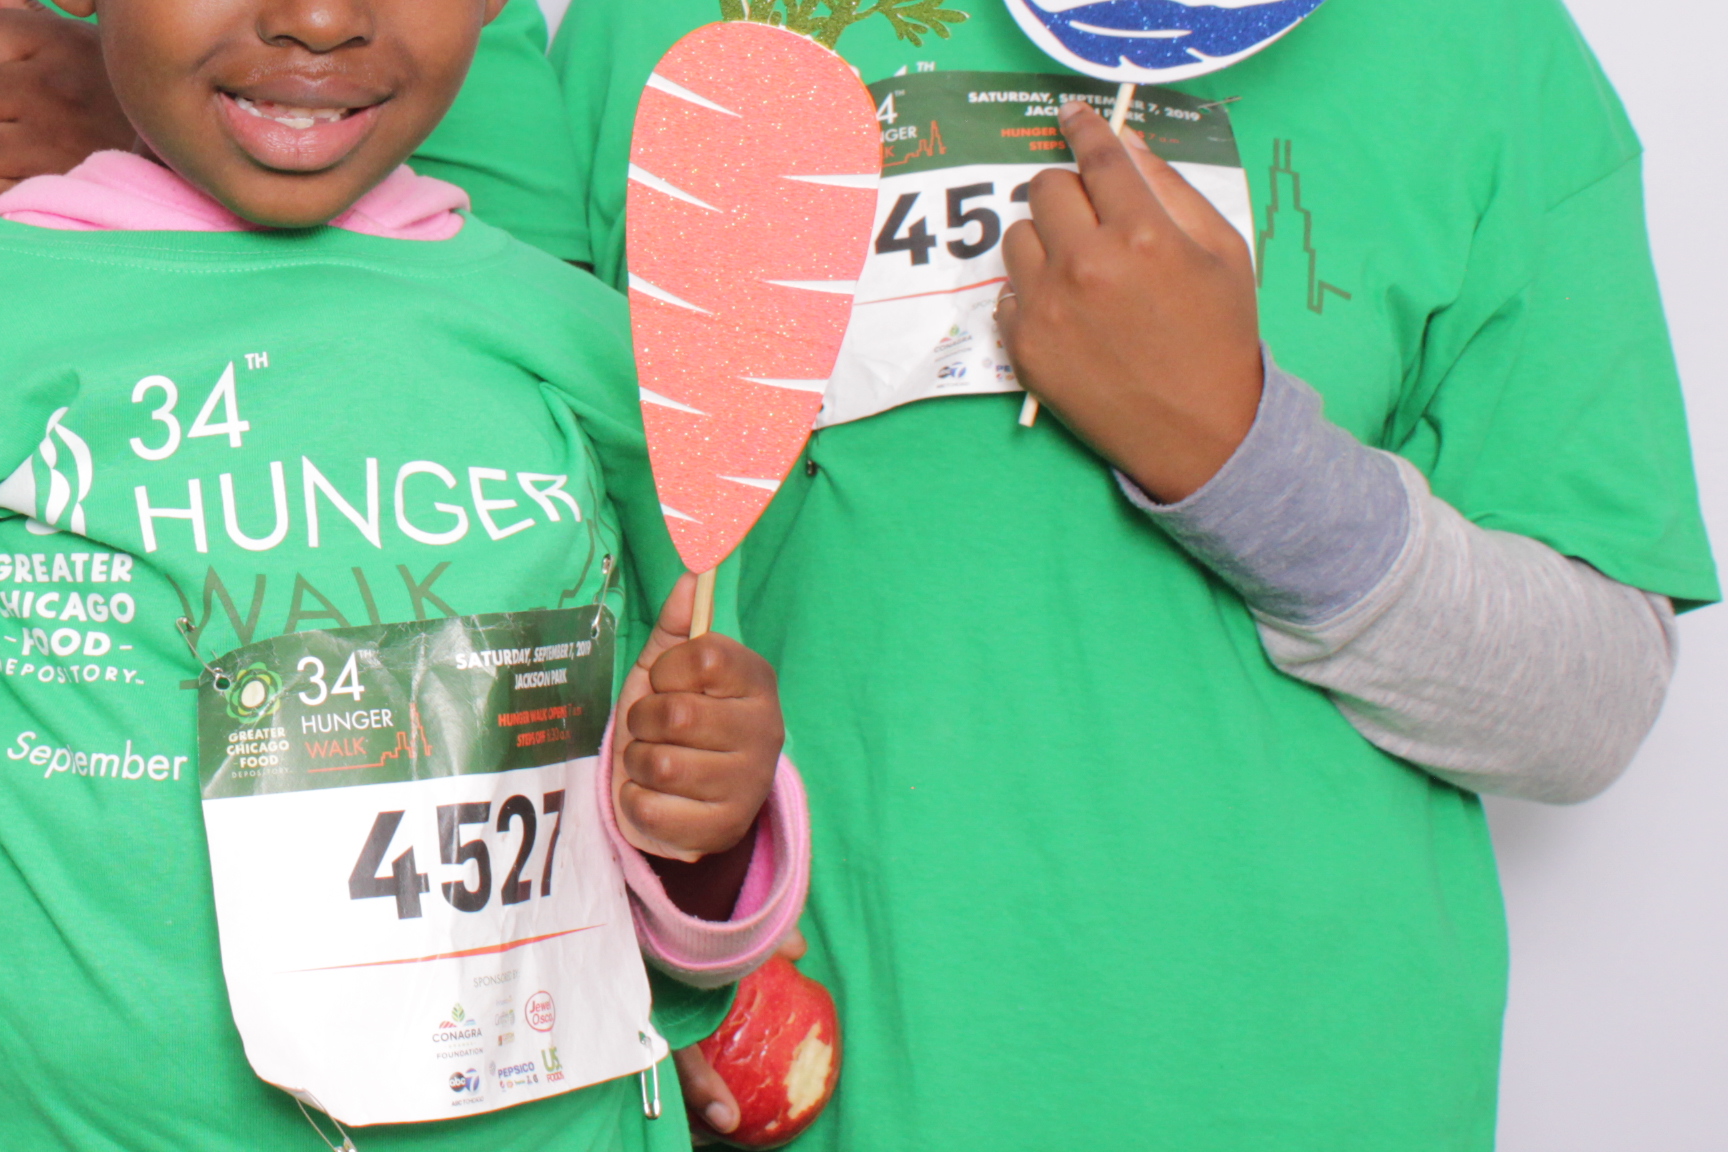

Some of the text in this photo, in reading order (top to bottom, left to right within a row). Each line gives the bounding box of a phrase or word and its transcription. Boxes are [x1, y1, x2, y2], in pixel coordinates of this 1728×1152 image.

[967, 91, 1054, 105] SATURDAY,
[1059, 93, 1145, 111] SEPTEMER
[1164, 107, 1201, 121] 2019
[1104, 108, 1146, 123] PRK
[1001, 127, 1057, 137] HUNGER
[1029, 141, 1066, 151] STEPS
[875, 182, 1030, 266] 45
[134, 454, 581, 553] HUNGER
[455, 648, 532, 670] SATURDAY,
[514, 670, 551, 690] JACKSON
[301, 709, 394, 735] HUNGER
[228, 727, 286, 743] GREATER
[226, 740, 290, 756] CHICAGO
[305, 737, 368, 759] WALK
[240, 755, 279, 768] FOOD
[348, 789, 566, 920] 4527
[432, 1028, 482, 1043] CONAGRA
[436, 1048, 484, 1060] FOUNDATION
[498, 1061, 535, 1079] PEPSICO
